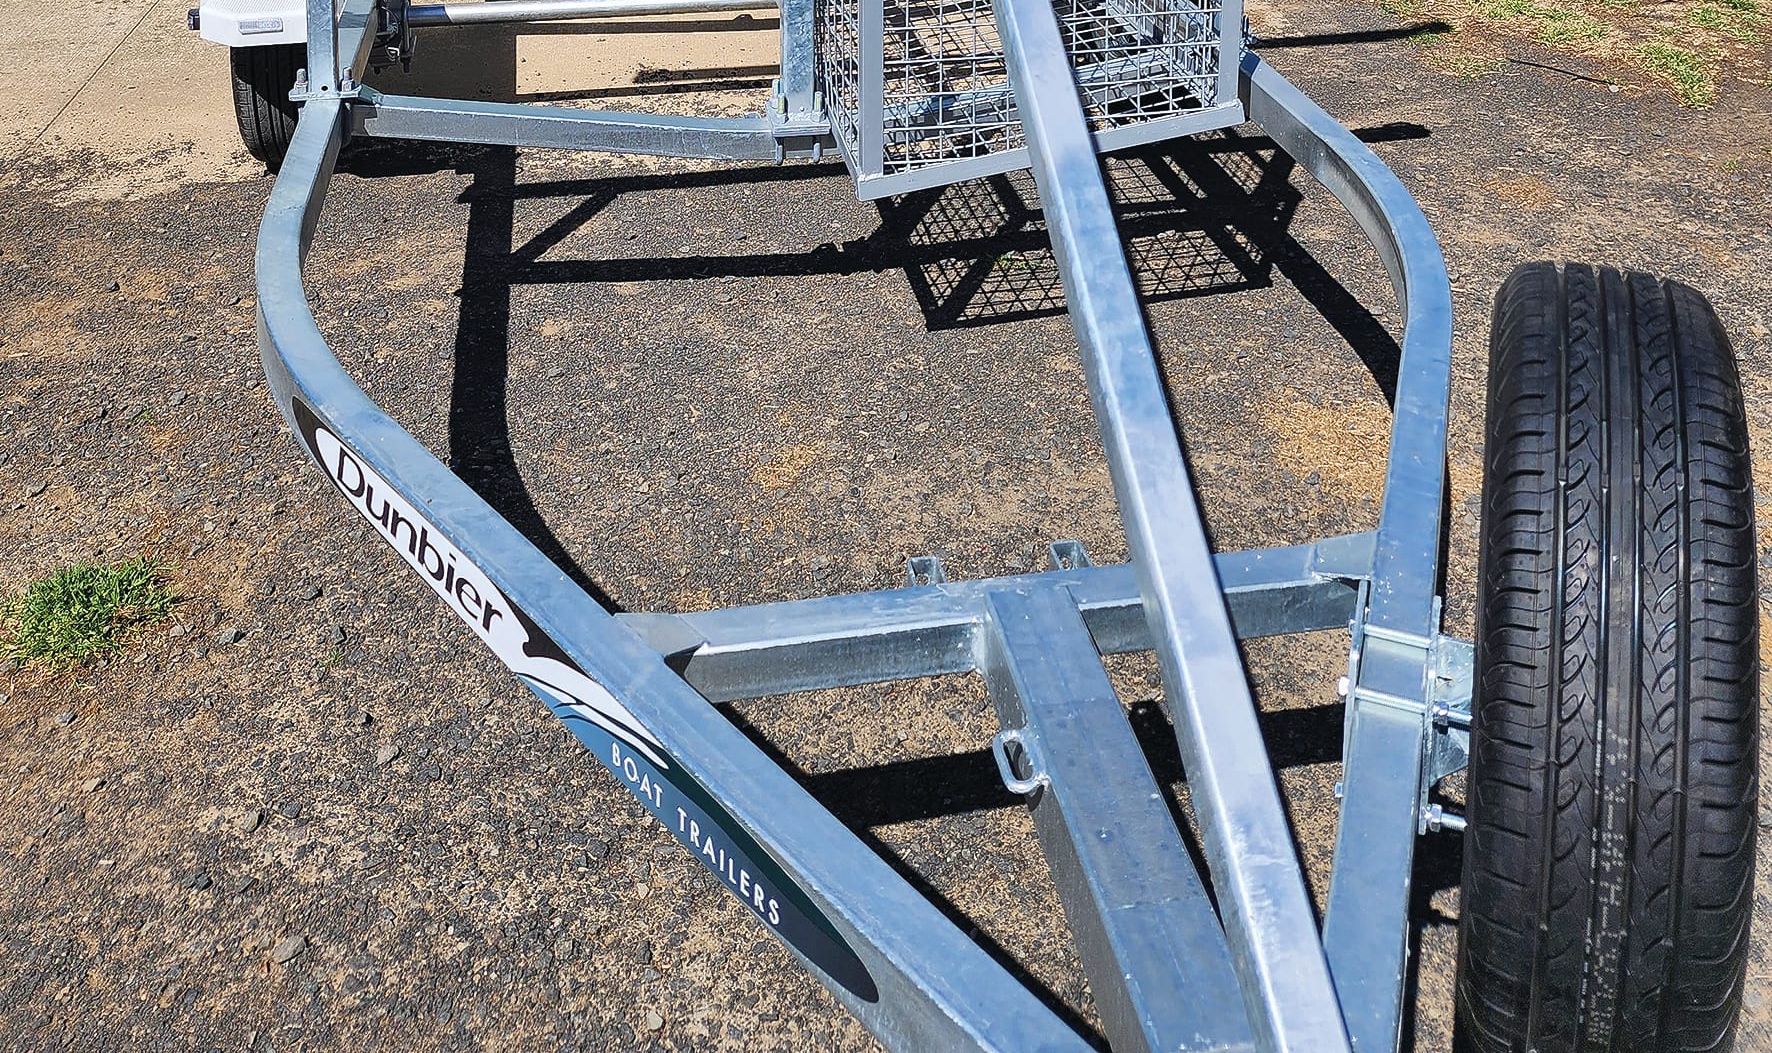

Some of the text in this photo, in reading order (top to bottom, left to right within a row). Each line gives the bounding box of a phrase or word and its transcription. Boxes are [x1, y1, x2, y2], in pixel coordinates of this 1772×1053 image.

[336, 443, 504, 633] Dunbier
[611, 741, 782, 926] BOAT TRAILERS
